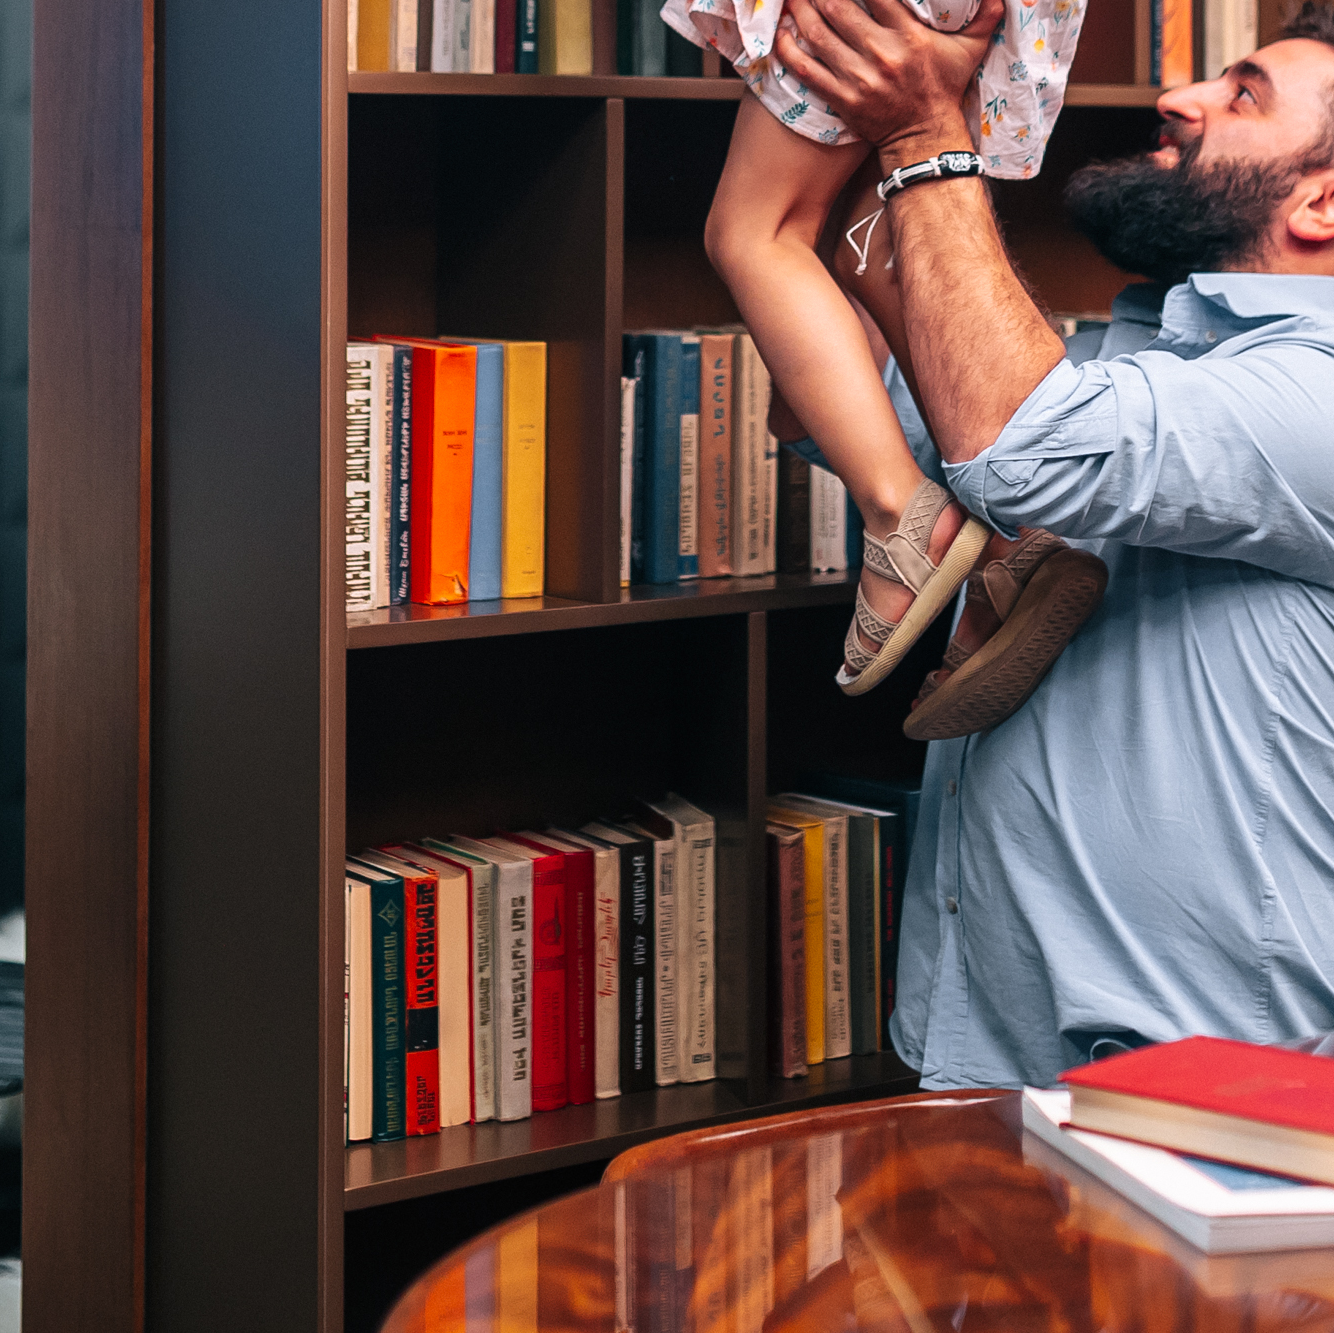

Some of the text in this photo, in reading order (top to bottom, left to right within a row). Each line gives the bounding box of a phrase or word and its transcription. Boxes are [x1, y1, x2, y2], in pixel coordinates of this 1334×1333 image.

[632, 855, 647, 965] ՄԵԾ ՀԱՐՍԱՆԻՔ
[384, 985, 399, 1051] ԱՌԱՋՆՈՐԴ
[511, 896, 527, 1081] ՍԵՎ ԱՍՊԵՏՆԵՐԻ ՄՈՏ
